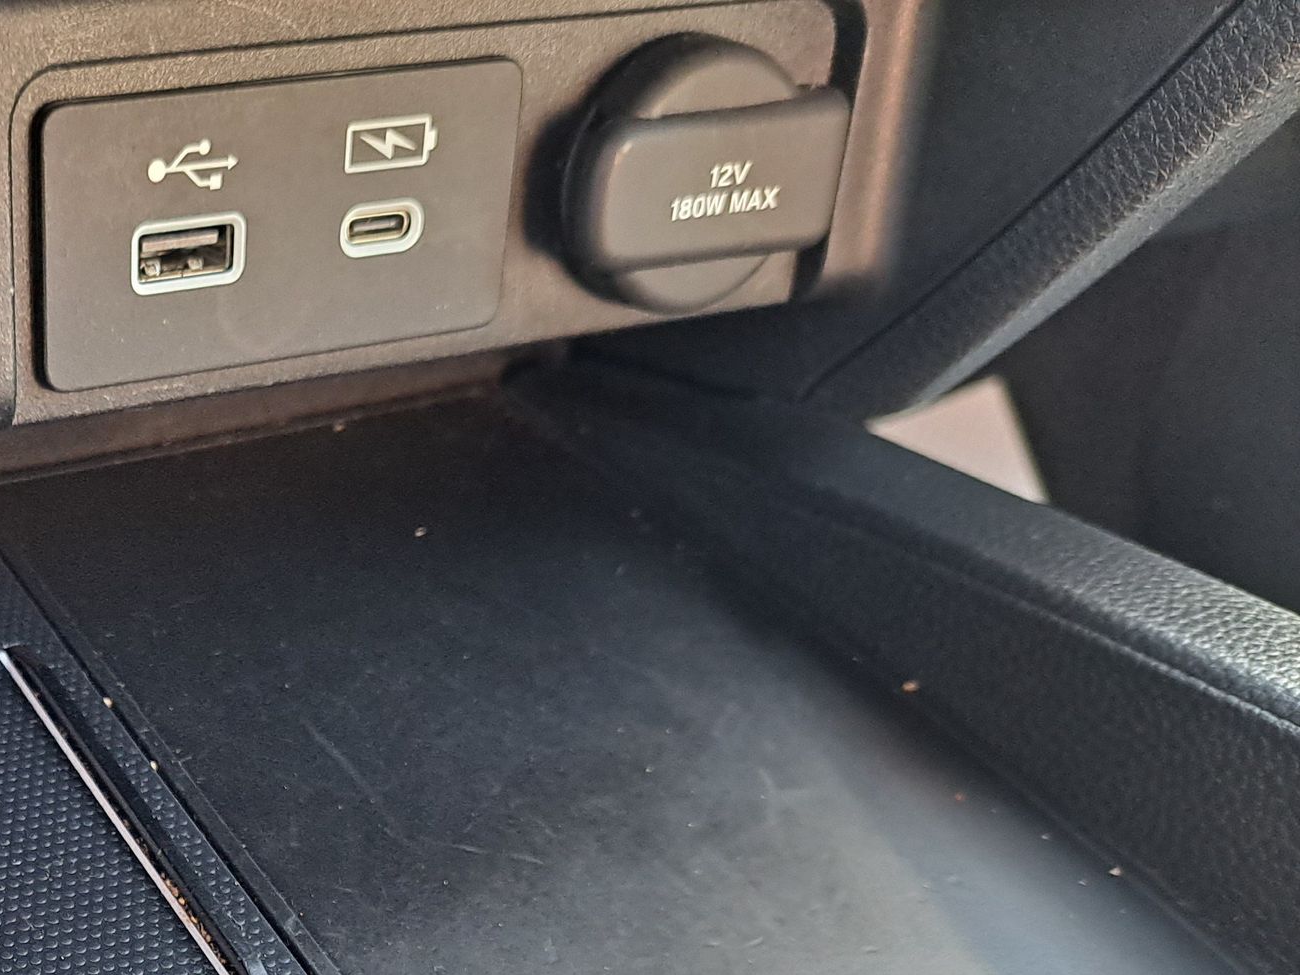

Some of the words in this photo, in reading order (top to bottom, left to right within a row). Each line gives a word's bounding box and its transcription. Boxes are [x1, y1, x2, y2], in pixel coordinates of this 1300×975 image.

[710, 161, 753, 188] 12V
[670, 191, 728, 222] 180W
[729, 185, 781, 214] MAX
